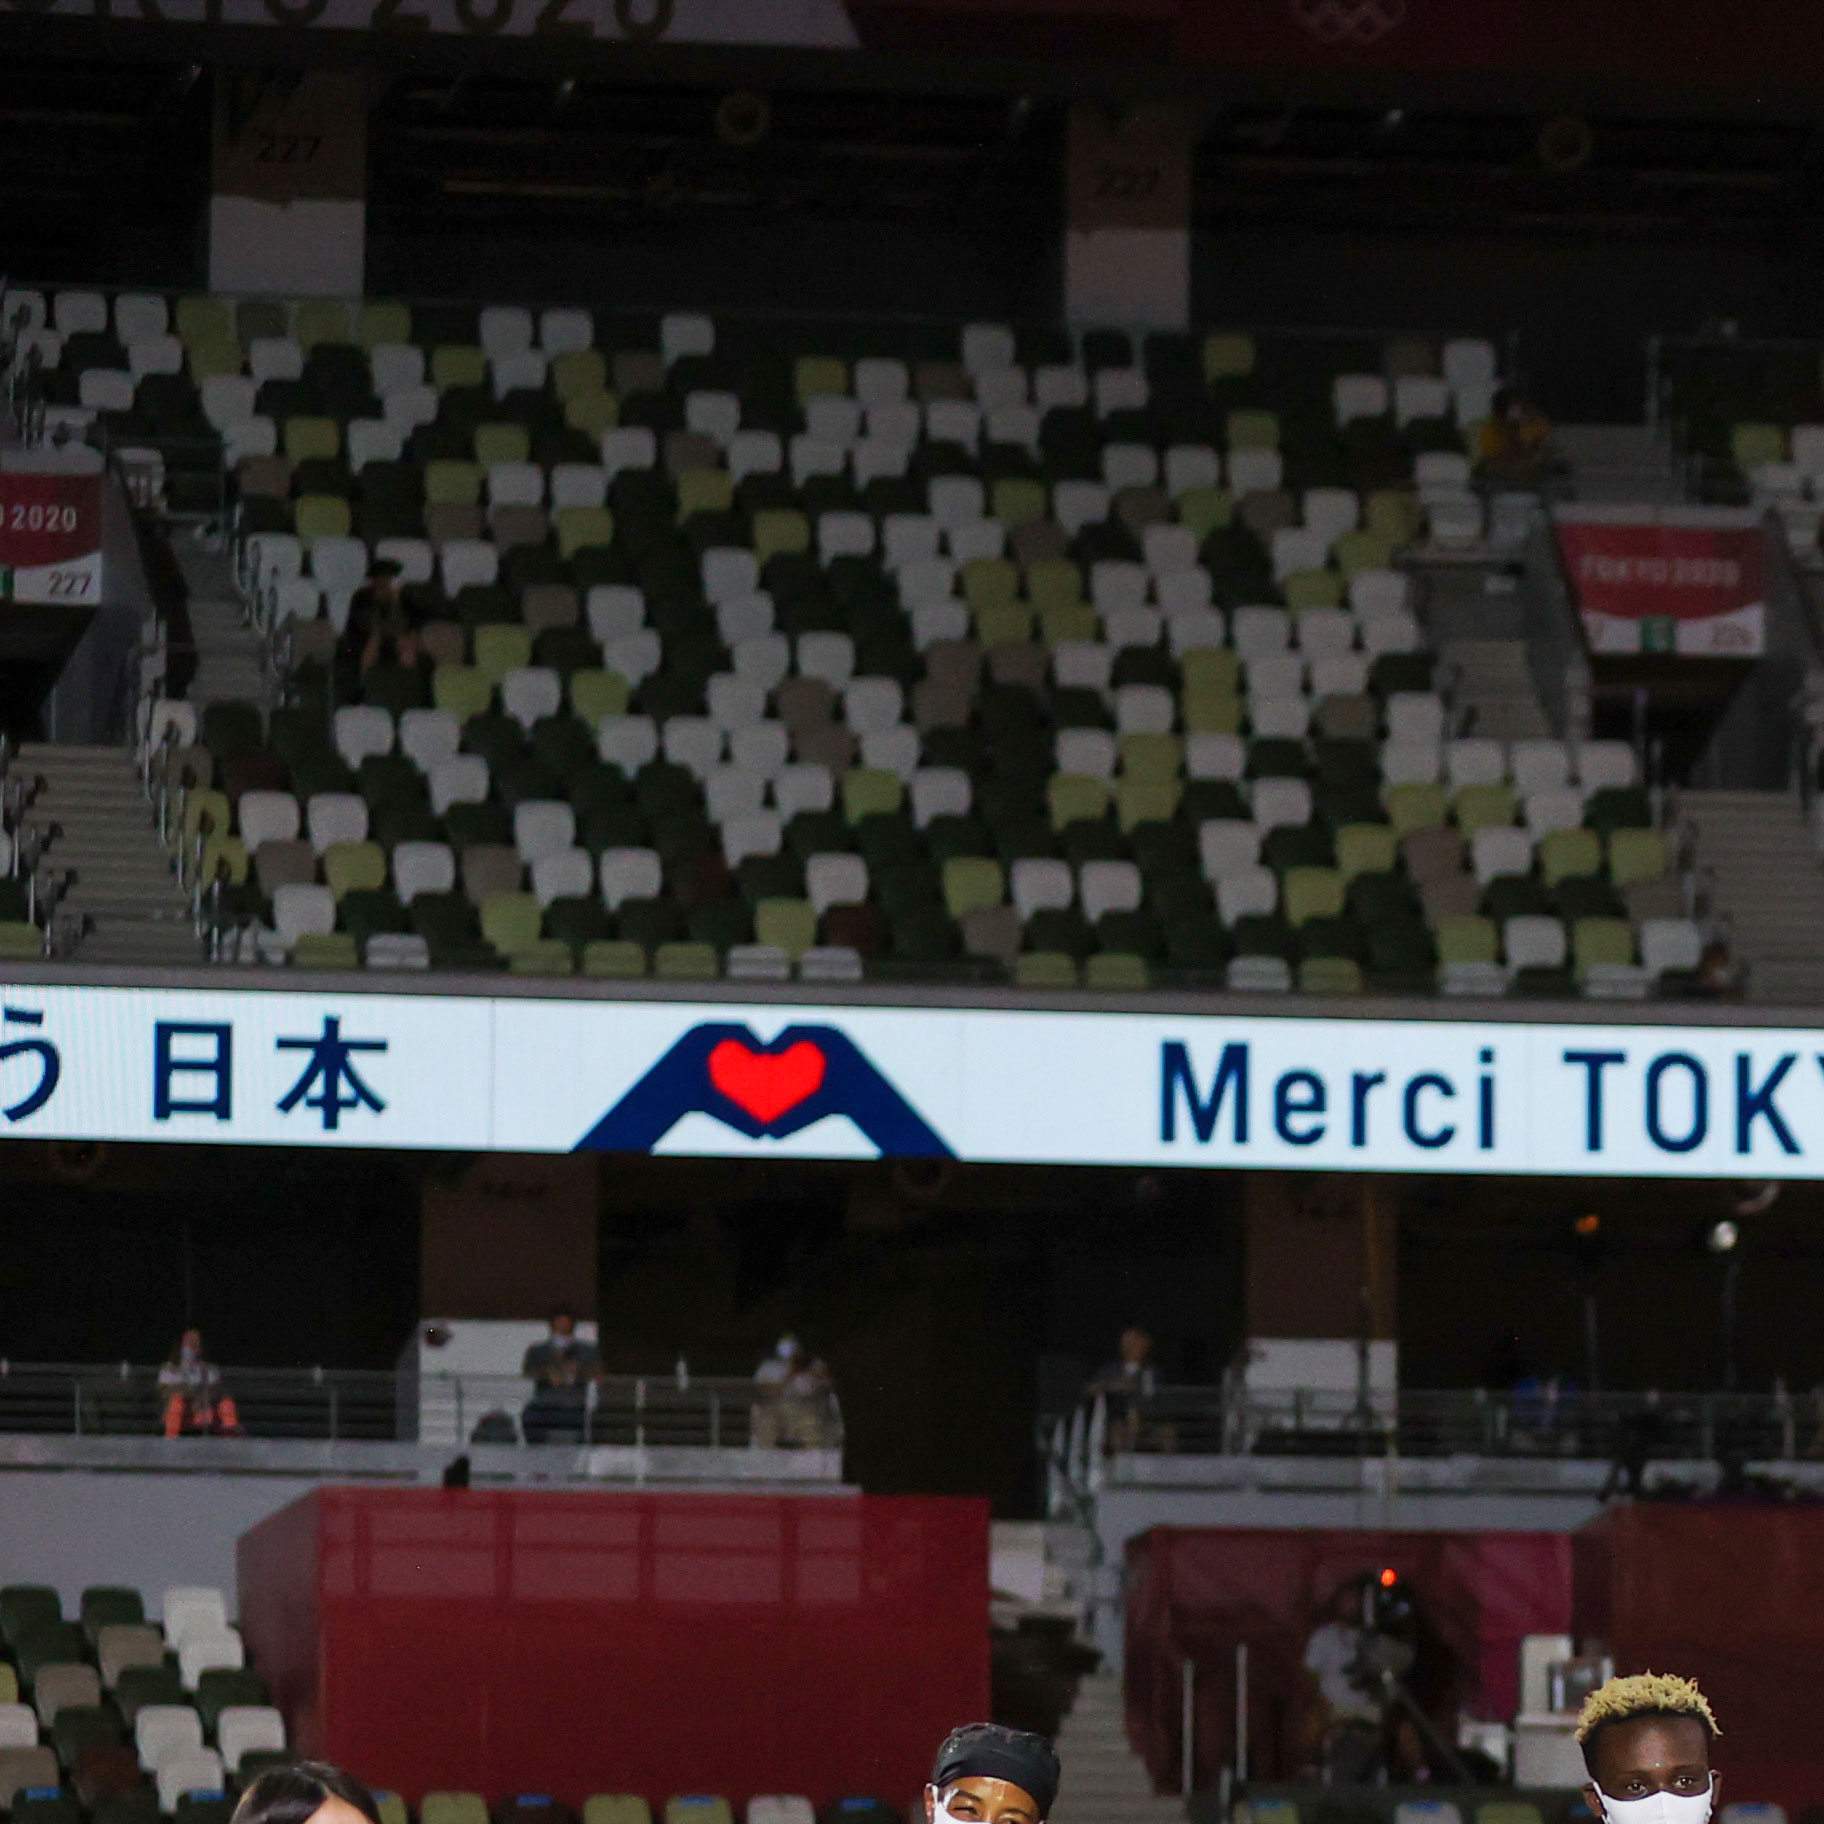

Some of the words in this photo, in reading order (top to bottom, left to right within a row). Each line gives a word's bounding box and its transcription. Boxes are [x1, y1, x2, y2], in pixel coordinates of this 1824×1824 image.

[256, 134, 322, 163] 227
[11, 504, 78, 532] 2020
[49, 571, 92, 595] 227
[153, 1015, 388, 1130] 日本
[1160, 1040, 1494, 1150] Merci
